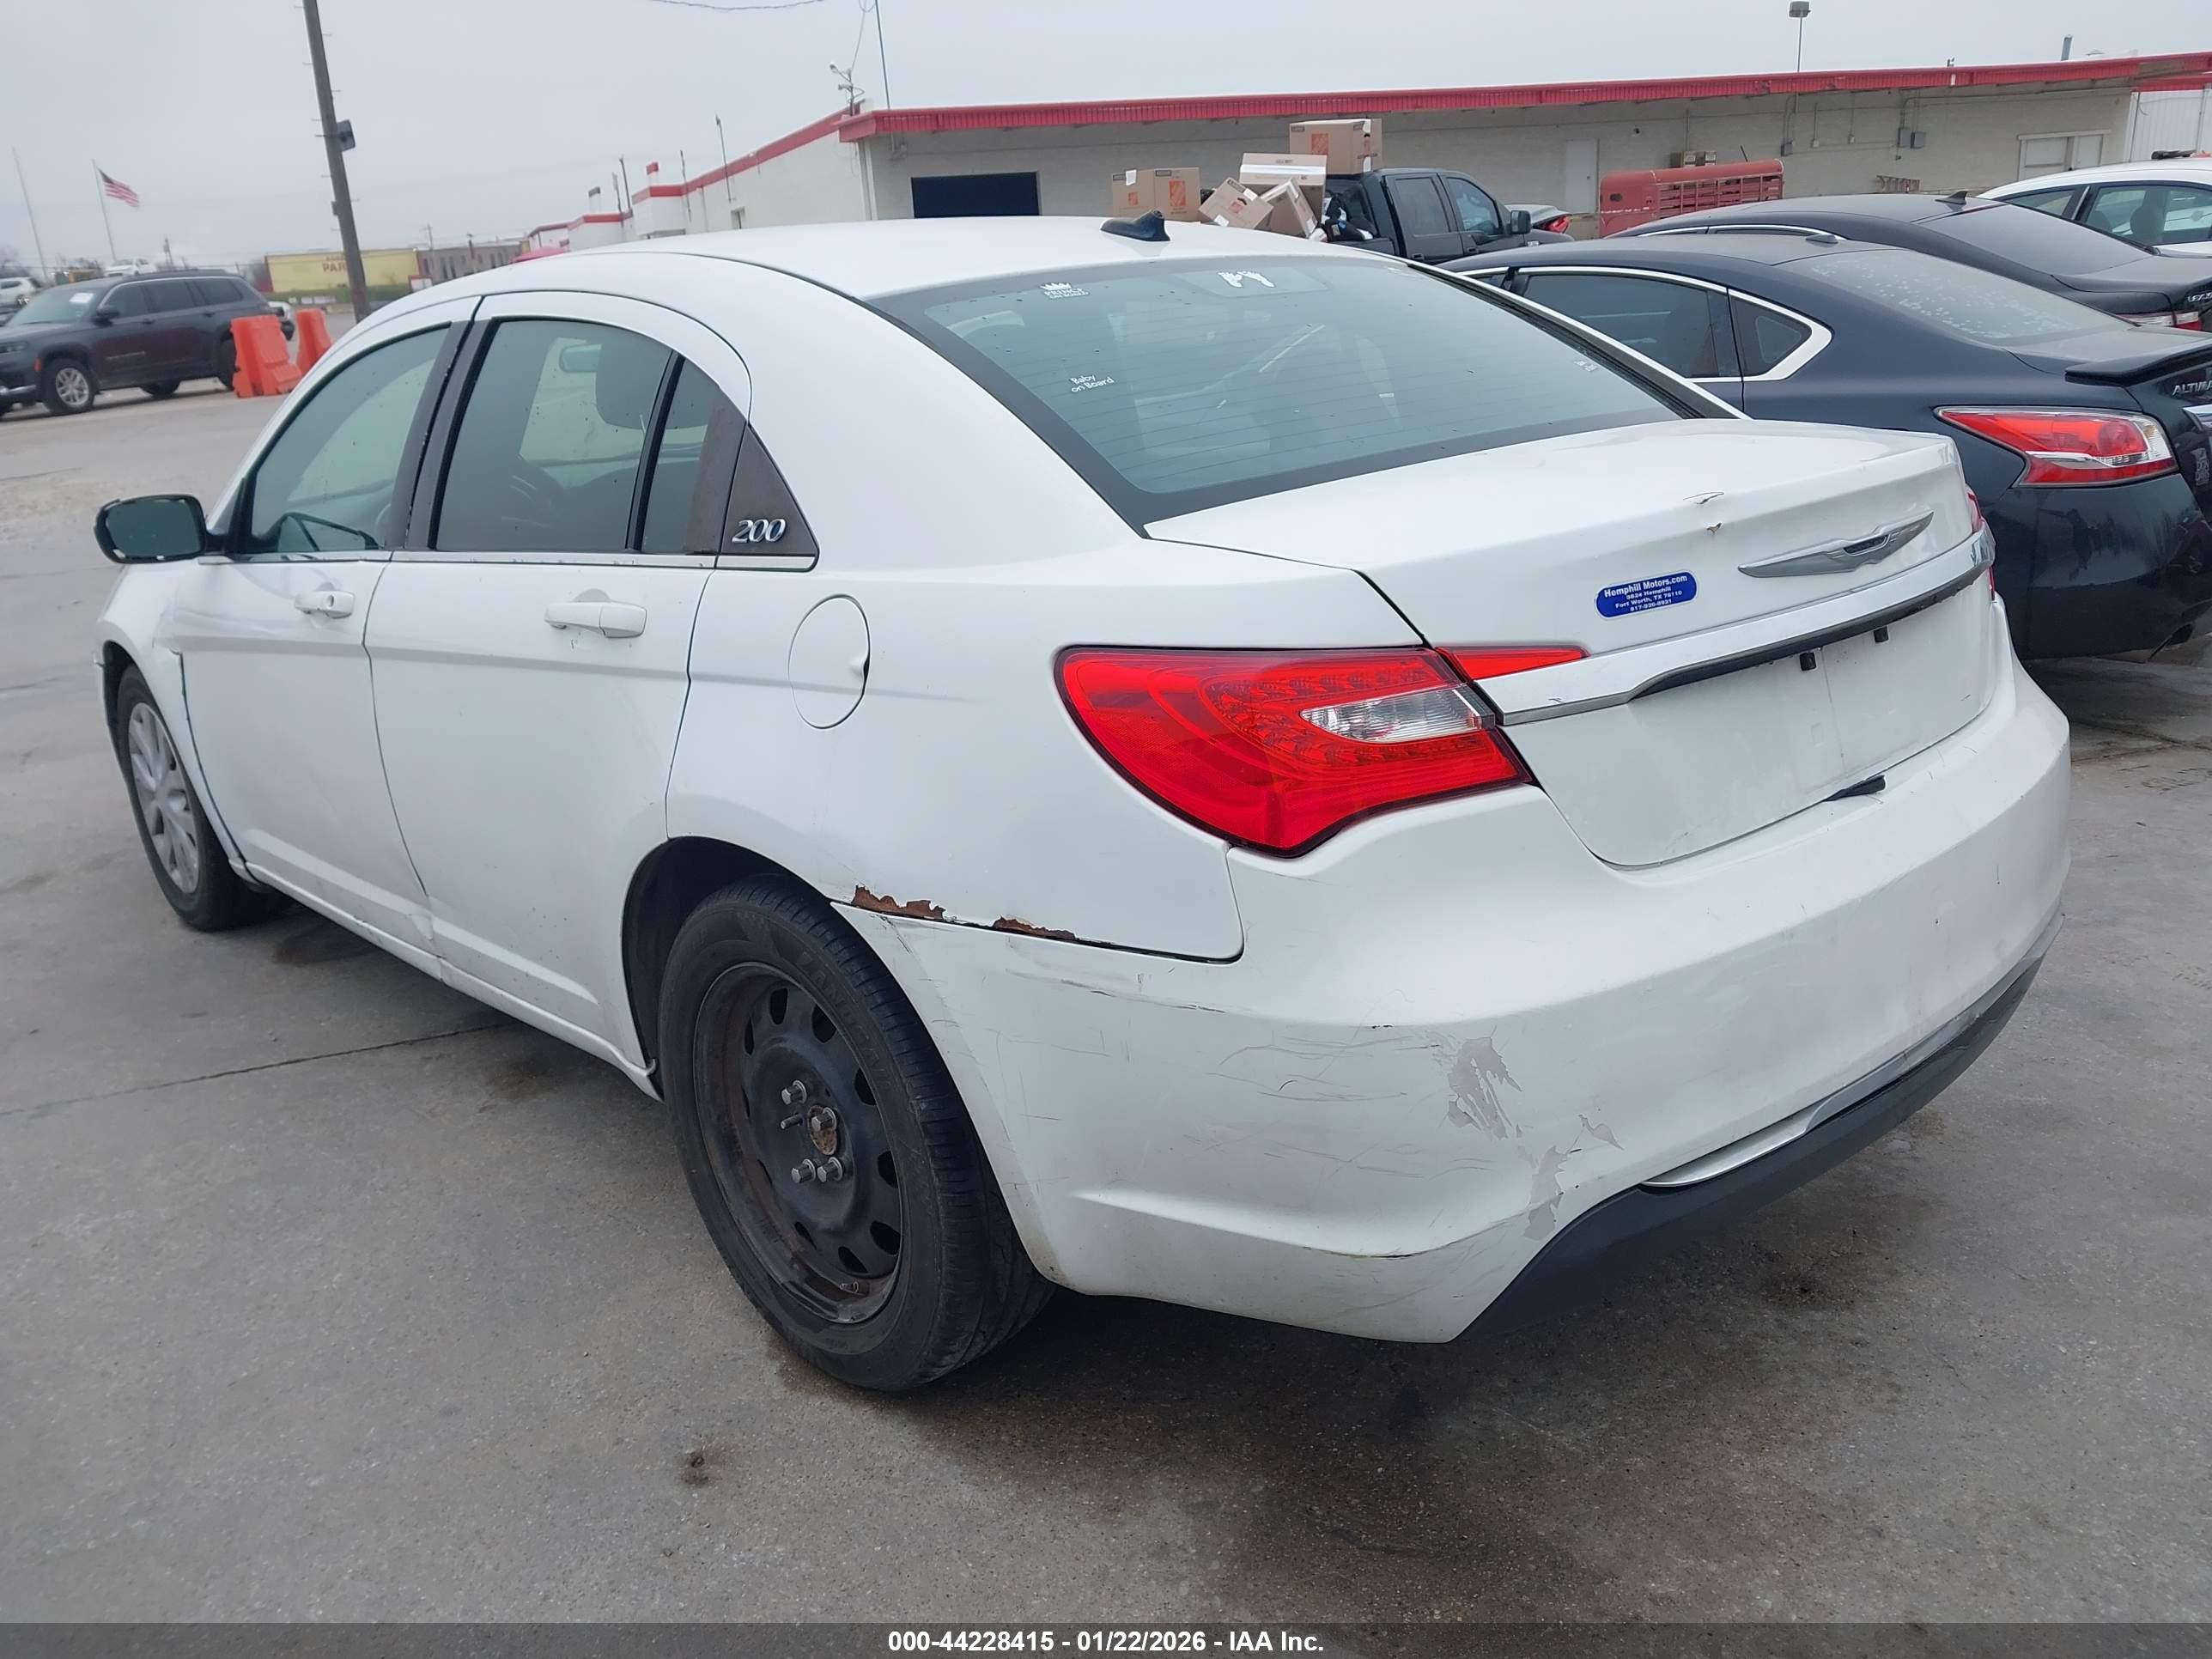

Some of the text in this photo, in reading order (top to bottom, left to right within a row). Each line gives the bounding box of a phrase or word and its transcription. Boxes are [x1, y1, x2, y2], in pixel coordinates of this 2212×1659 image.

[1070, 374, 1096, 385] Baby
[1084, 376, 1115, 389] Board
[732, 519, 787, 543] 200
[1604, 575, 1687, 599] Hemphill Motors.com
[1644, 586, 1671, 596] Hemphill
